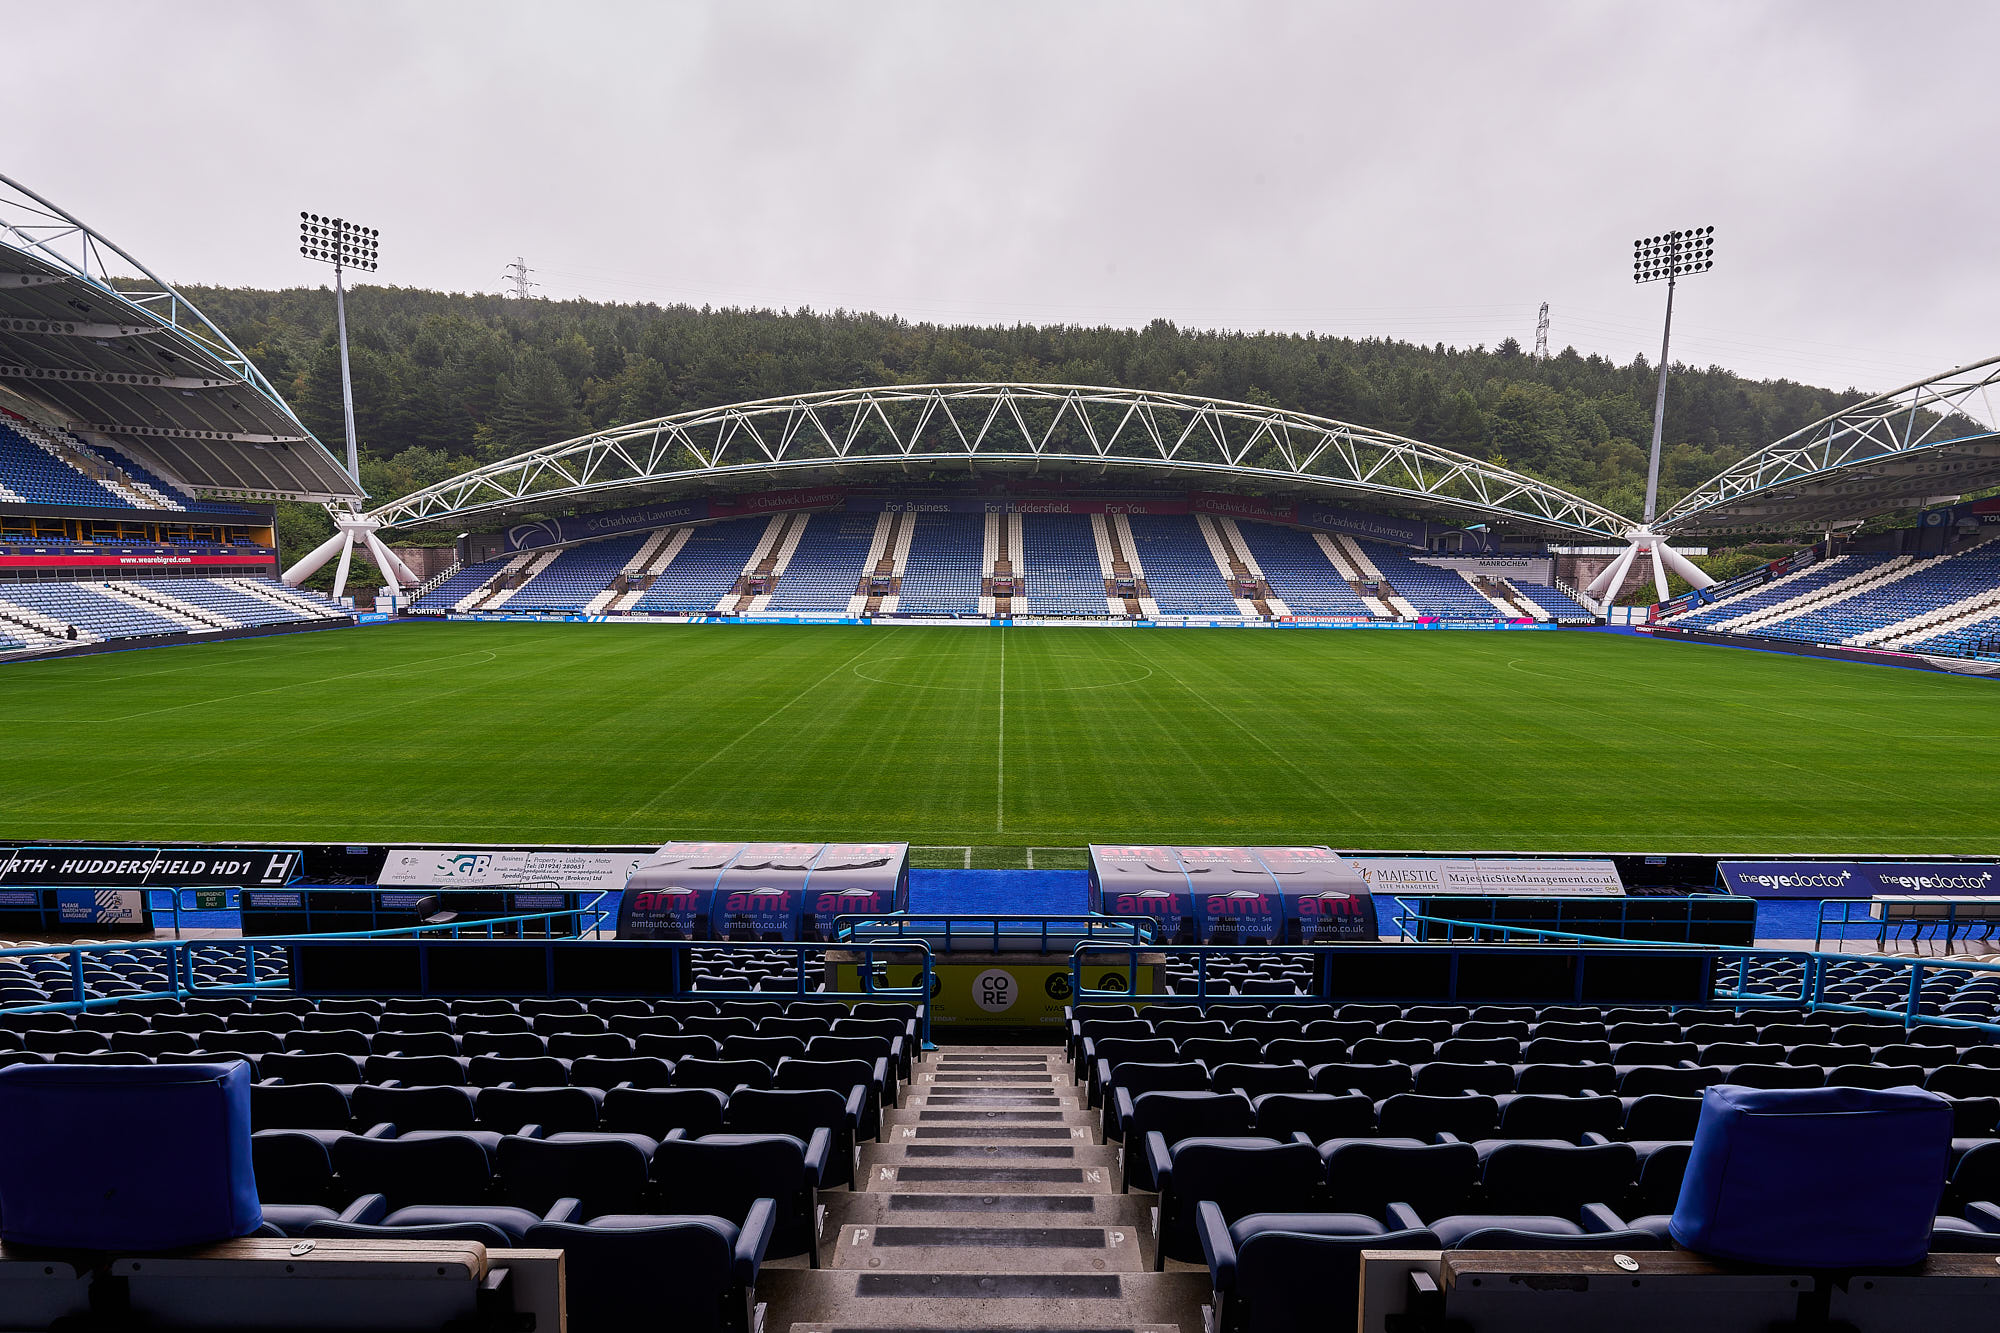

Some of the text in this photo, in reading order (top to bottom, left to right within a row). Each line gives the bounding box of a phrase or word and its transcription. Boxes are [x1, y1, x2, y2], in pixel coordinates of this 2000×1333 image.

[885, 501, 950, 512] For Business.
[985, 502, 1071, 513] For Huddersfield.
[1105, 503, 1148, 514] For You.
[599, 506, 690, 528] Chadwick Lawrence
[1322, 514, 1414, 540] Chadwick Lawrence
[120, 556, 192, 565] www.wearebigred.com
[59, 860, 206, 874] HUDDERSFIELD
[210, 861, 251, 875] HD1
[264, 854, 293, 878] H
[434, 853, 492, 877] SGB
[534, 857, 557, 865] Property
[538, 863, 561, 871] (01924)
[502, 873, 530, 881] Spedding
[531, 874, 564, 882] Goldthorpe
[1376, 869, 1438, 883] MAJESTIC
[1449, 873, 1618, 886] MajesticSiteManagement.co.uk
[634, 890, 699, 911] amt
[725, 890, 791, 911] amt
[816, 891, 880, 912] amt
[1116, 893, 1181, 914] amt
[1207, 894, 1271, 914] amt
[1298, 894, 1362, 915] amt
[631, 920, 695, 928] amtauto.co.uk
[724, 921, 788, 929] amtauto.co.uk
[1208, 924, 1272, 932] amtauto.co.uk
[1301, 924, 1364, 933] amtauto.co.uk
[982, 976, 1009, 990] CO
[983, 991, 1007, 1005] RE
[852, 1229, 869, 1246] P
